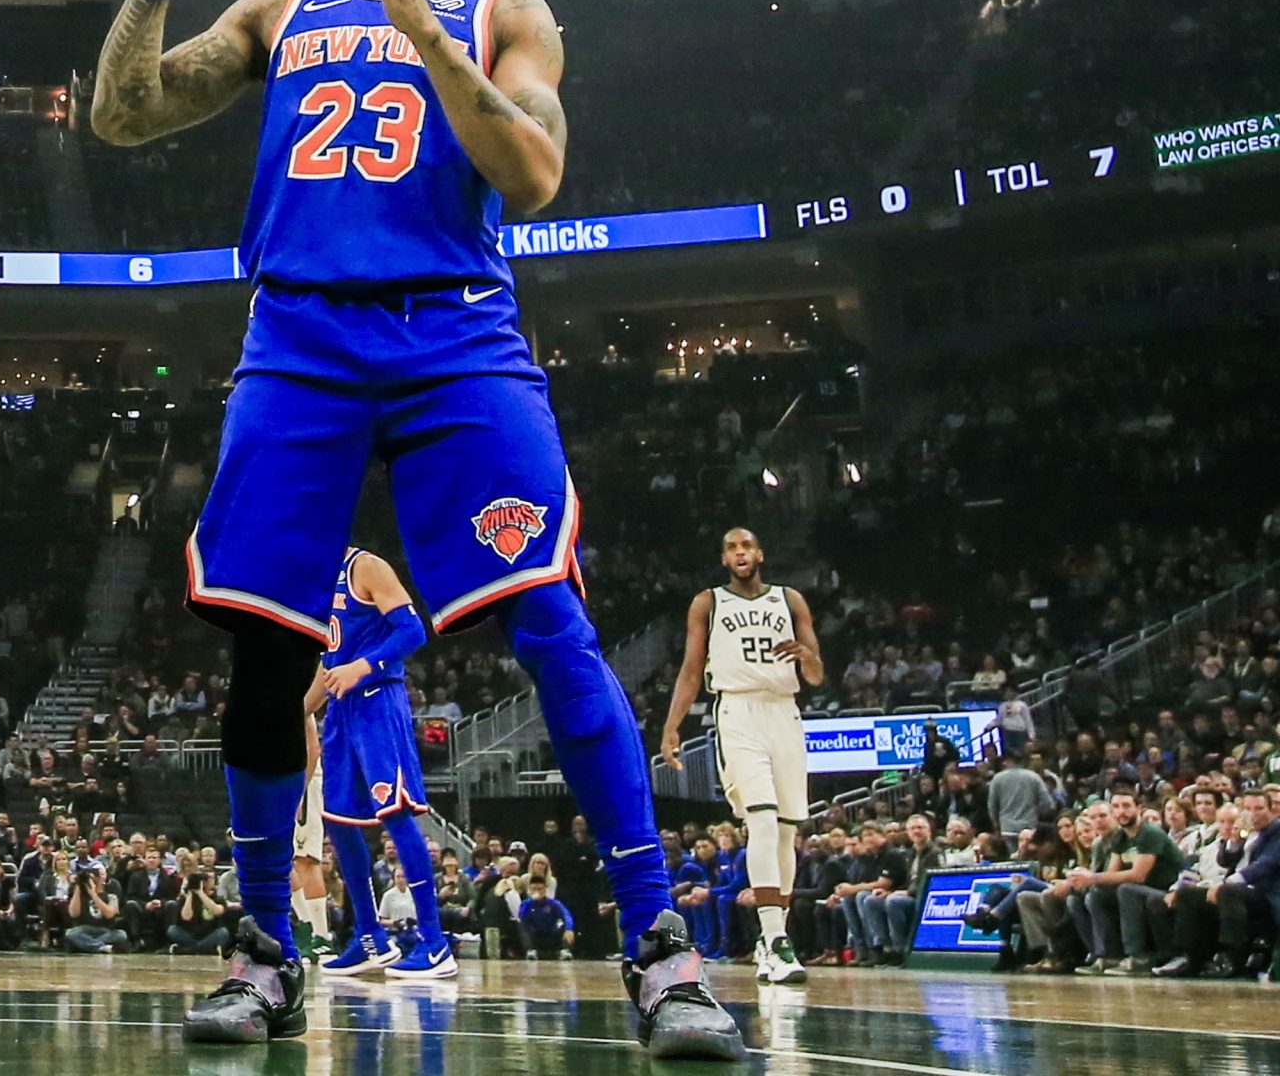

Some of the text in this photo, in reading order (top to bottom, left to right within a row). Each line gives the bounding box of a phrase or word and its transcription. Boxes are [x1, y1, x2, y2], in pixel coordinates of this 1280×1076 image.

[276, 25, 368, 79] NEW
[287, 80, 427, 183] 23
[1154, 115, 1274, 150] WHO WANTS A
[1158, 133, 1280, 167] LAW OFFICES?
[986, 146, 1114, 194] TOL 7
[796, 185, 906, 228] FLS 0
[512, 220, 609, 255] Knicks
[129, 257, 153, 282] 6
[479, 504, 542, 538] KNICKS
[721, 610, 787, 633] BUCKS
[741, 637, 774, 663] 22
